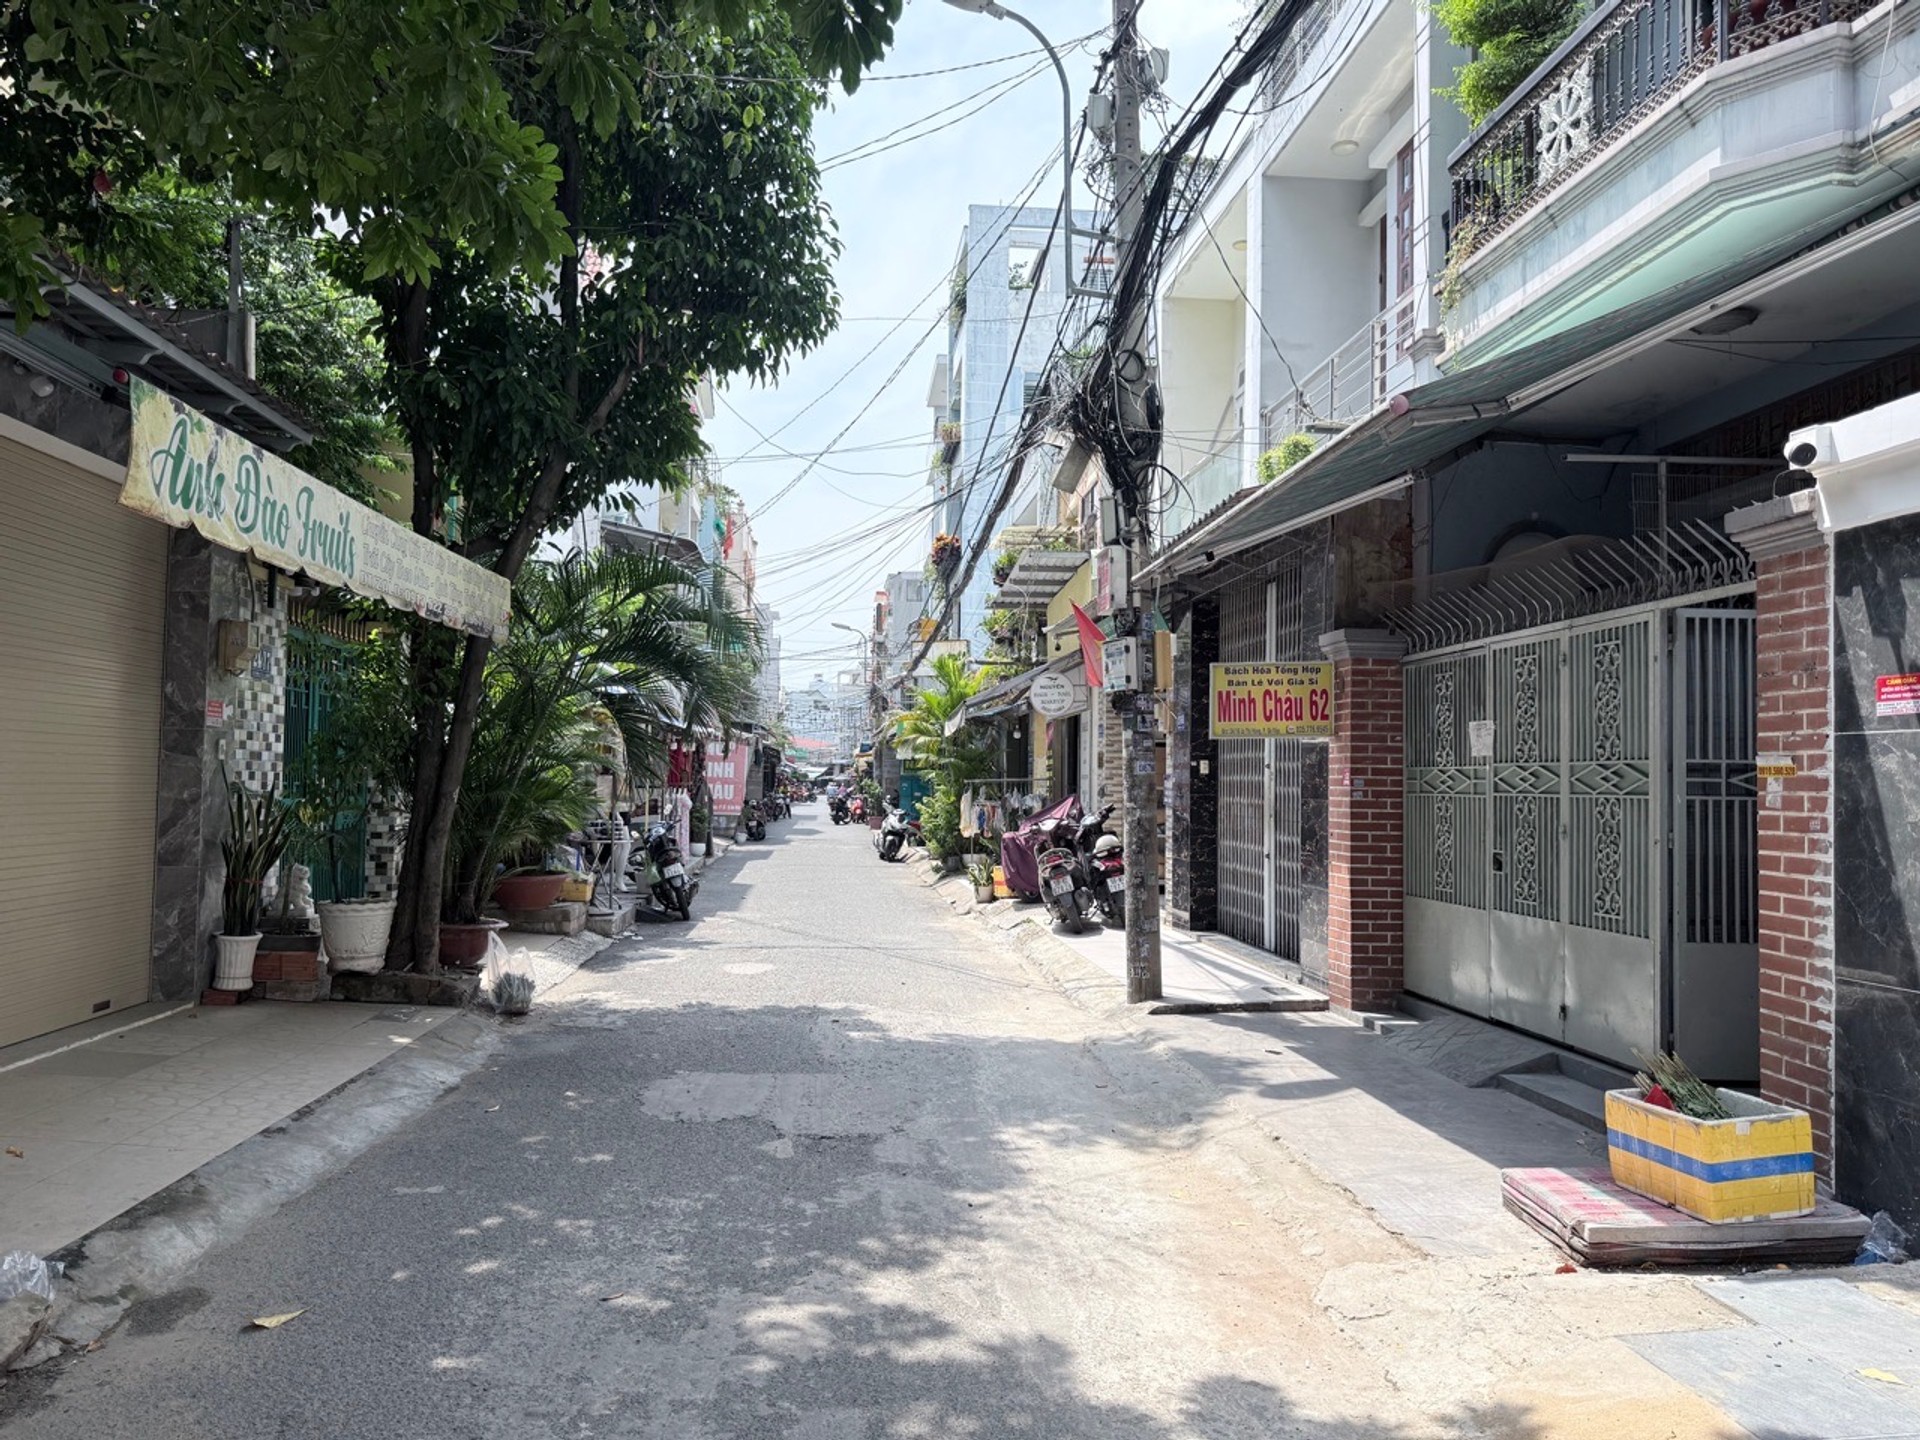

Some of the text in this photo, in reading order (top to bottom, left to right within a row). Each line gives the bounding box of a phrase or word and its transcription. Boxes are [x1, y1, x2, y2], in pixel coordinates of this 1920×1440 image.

[151, 416, 226, 519] Anh
[234, 453, 291, 550] Đào
[296, 486, 356, 579] Fruits
[1224, 664, 1322, 676] Bách Hóa Tổng Hợp
[1227, 679, 1248, 687] Bán
[1287, 677, 1305, 686] Giá
[1217, 690, 1257, 722] Minh
[1263, 688, 1303, 722] Châu
[1309, 688, 1330, 721] 62
[704, 762, 735, 778] INH
